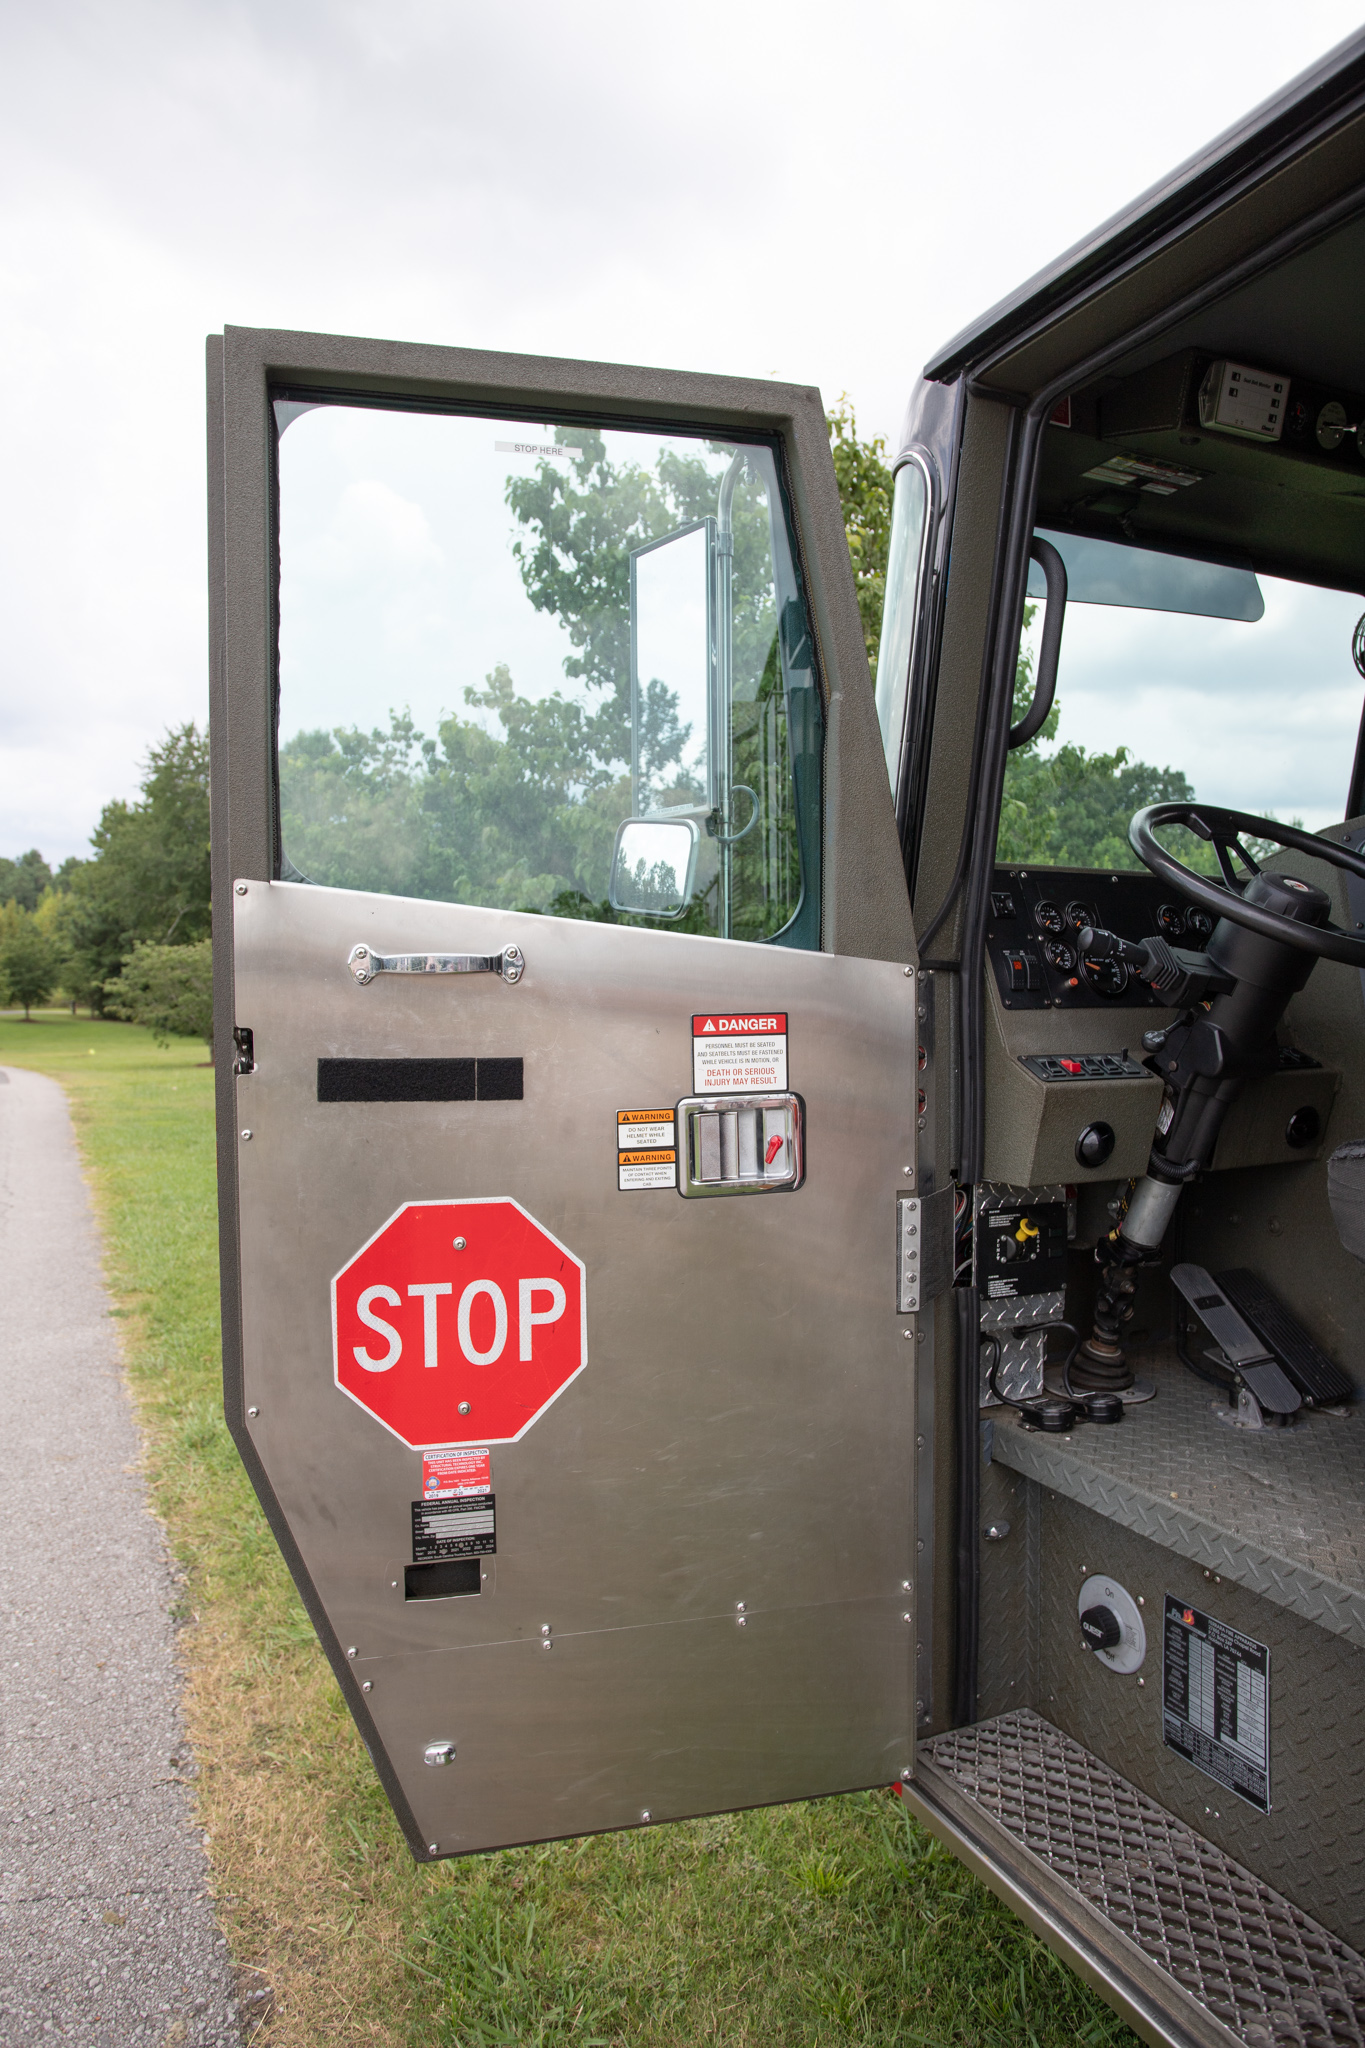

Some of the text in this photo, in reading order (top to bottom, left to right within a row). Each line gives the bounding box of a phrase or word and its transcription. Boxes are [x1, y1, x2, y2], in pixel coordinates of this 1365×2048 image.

[540, 447, 562, 455] HERE
[719, 1019, 777, 1031] DANGER
[353, 1277, 567, 1372] STOP
[1105, 1587, 1114, 1598] On
[1083, 1621, 1104, 1638] GUEST
